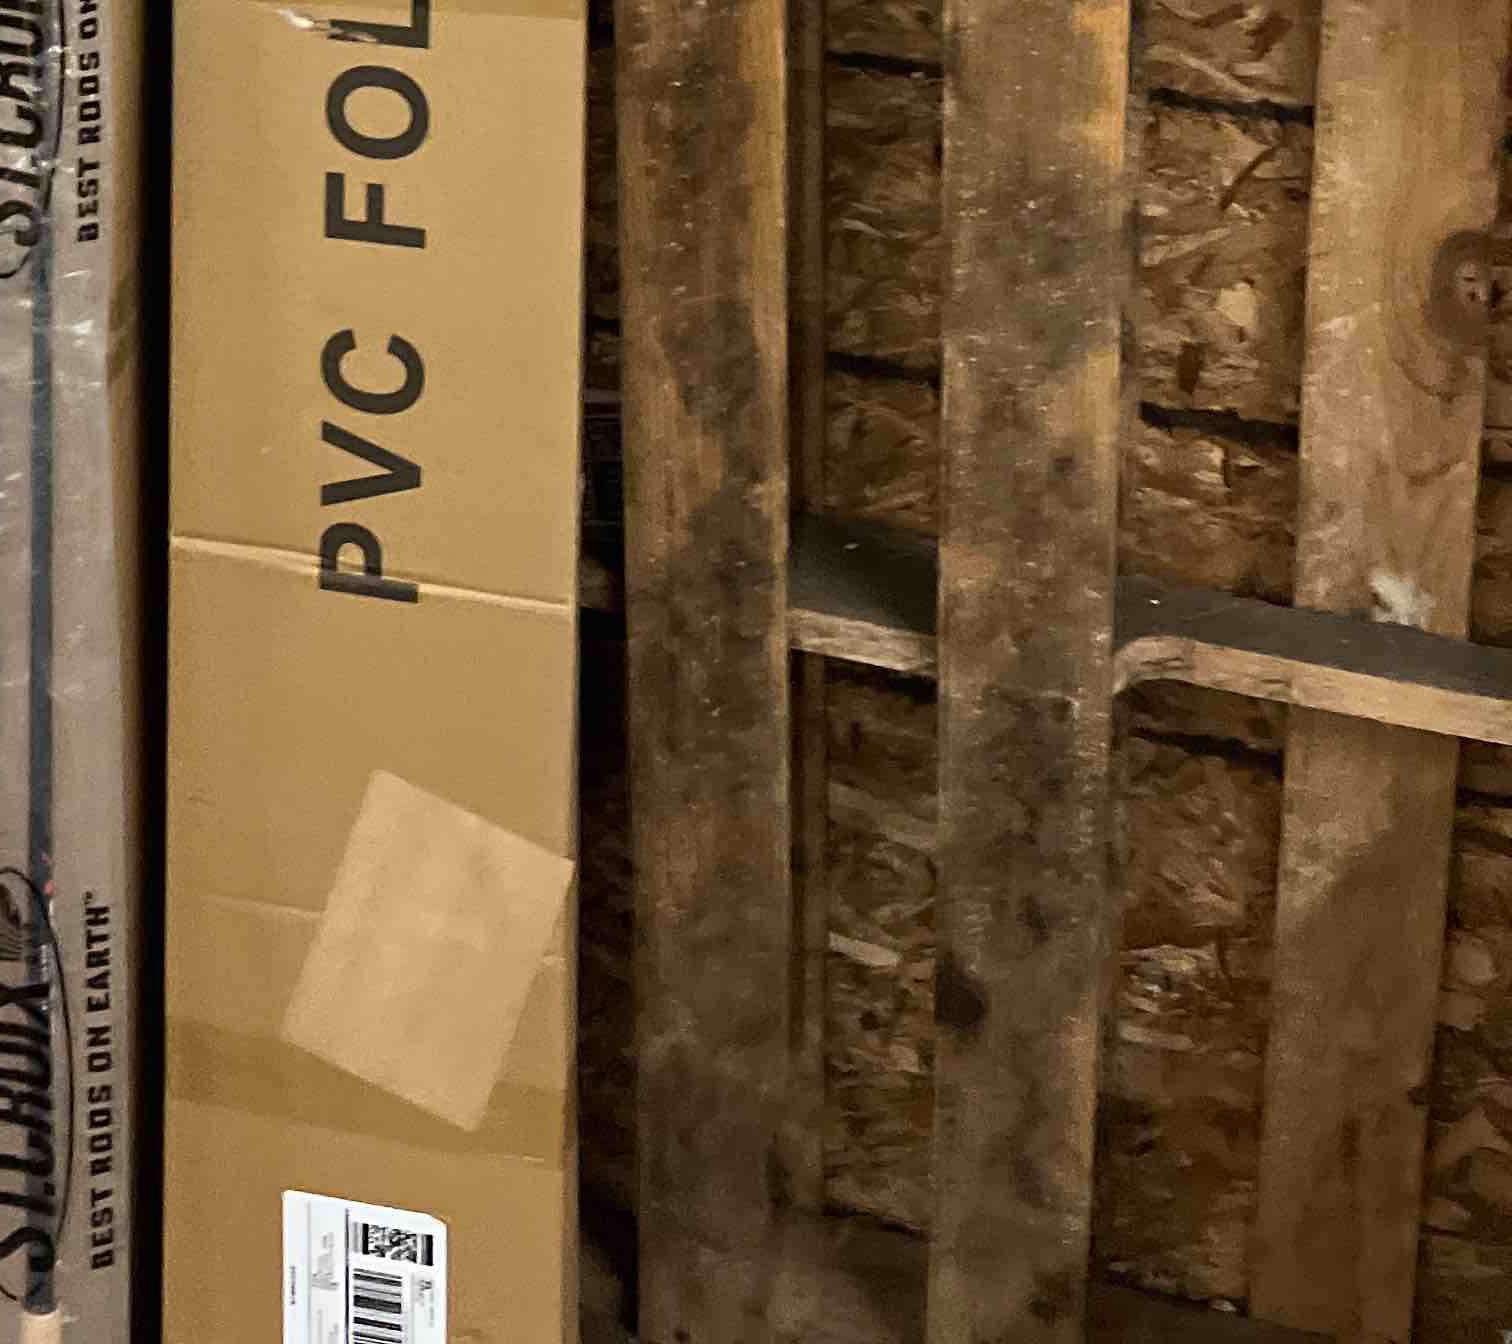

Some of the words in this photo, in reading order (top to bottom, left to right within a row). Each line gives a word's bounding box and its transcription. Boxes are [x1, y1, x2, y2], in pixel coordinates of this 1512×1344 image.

[78, 51, 102, 143] RODS
[76, 165, 101, 243] BEST
[319, 327, 426, 602] PVC
[88, 1028, 113, 1075] ON
[88, 1084, 115, 1177] RODS
[90, 1188, 116, 1272] BEST
